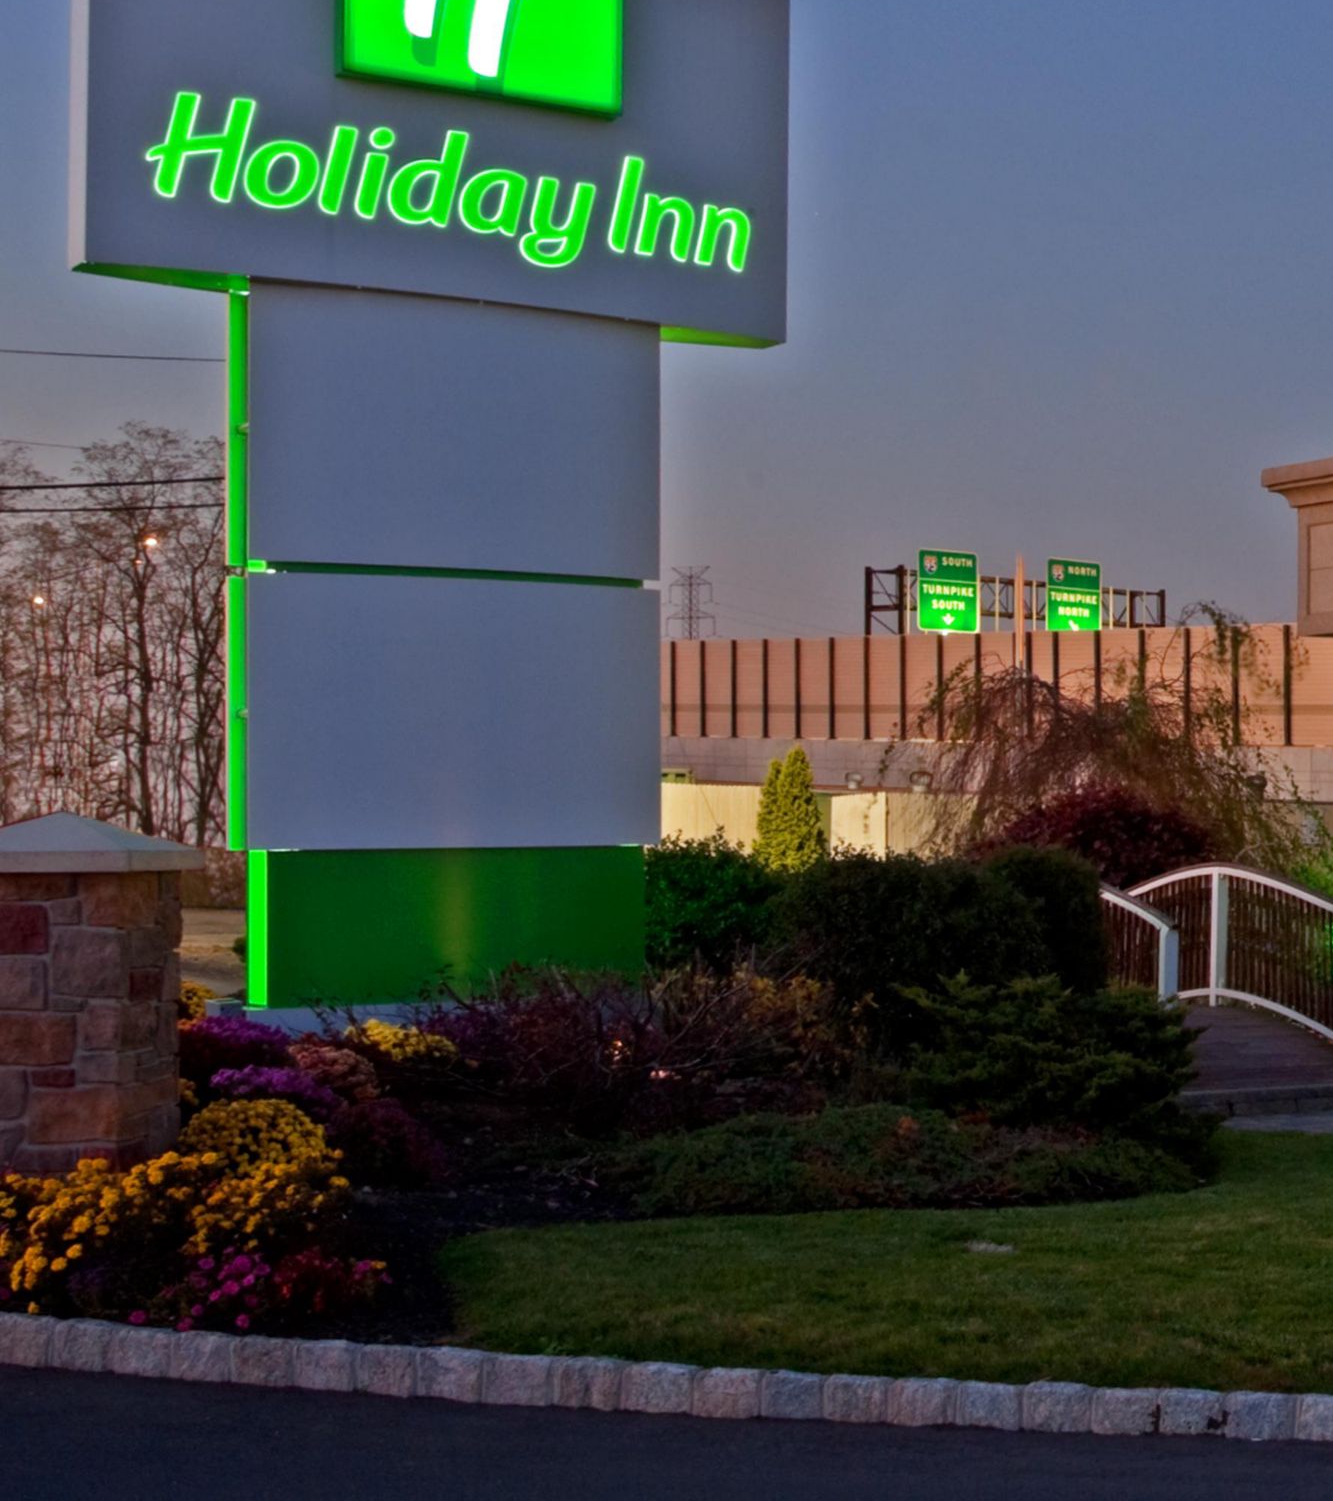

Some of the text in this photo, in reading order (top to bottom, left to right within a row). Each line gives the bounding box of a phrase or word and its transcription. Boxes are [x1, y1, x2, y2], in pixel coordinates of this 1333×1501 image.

[145, 91, 752, 272] Holiday Inn
[941, 556, 974, 568] SOUTH
[1067, 566, 1097, 577] NORTH
[922, 584, 974, 597] TURNPIKE
[1050, 591, 1097, 605] TURNPIKE
[931, 599, 966, 611] SOUTH
[1058, 606, 1090, 618] NORTH
